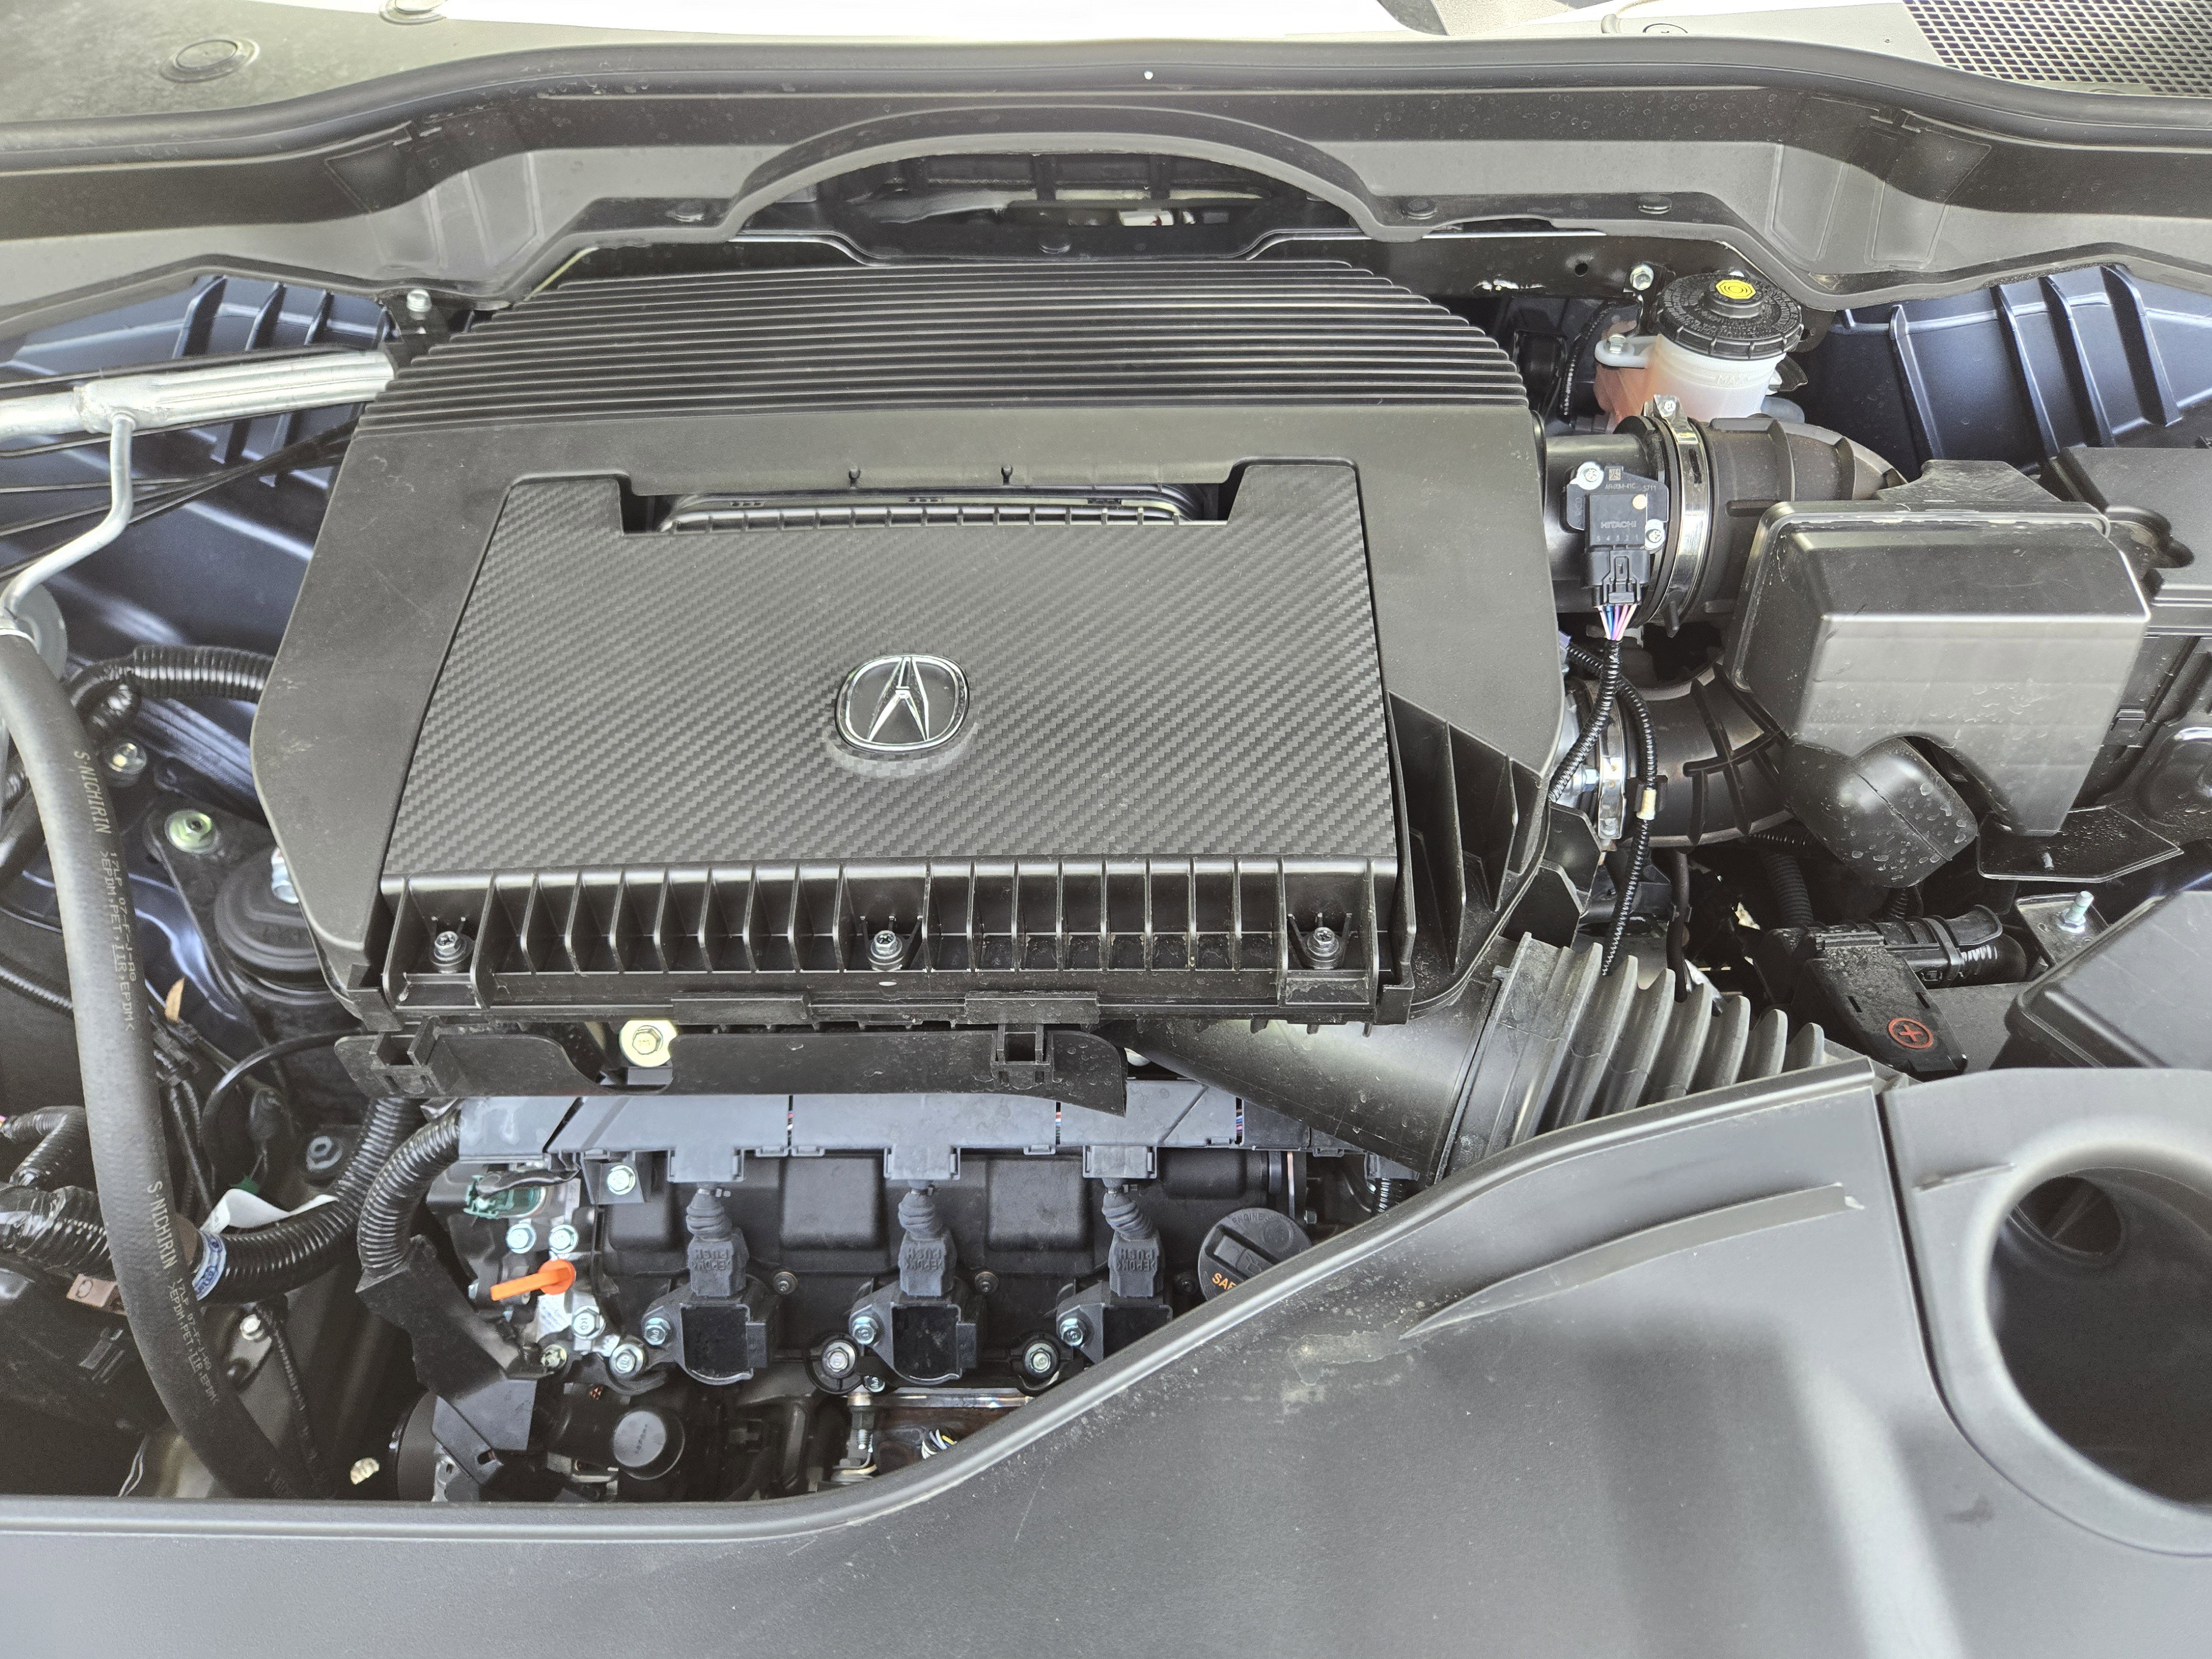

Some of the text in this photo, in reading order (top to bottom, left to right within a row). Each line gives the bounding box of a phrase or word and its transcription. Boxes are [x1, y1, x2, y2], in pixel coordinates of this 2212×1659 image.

[1716, 374, 1745, 385] MAX
[1600, 520, 1637, 529] HITACHI
[1120, 1249, 1155, 1260] PUSH
